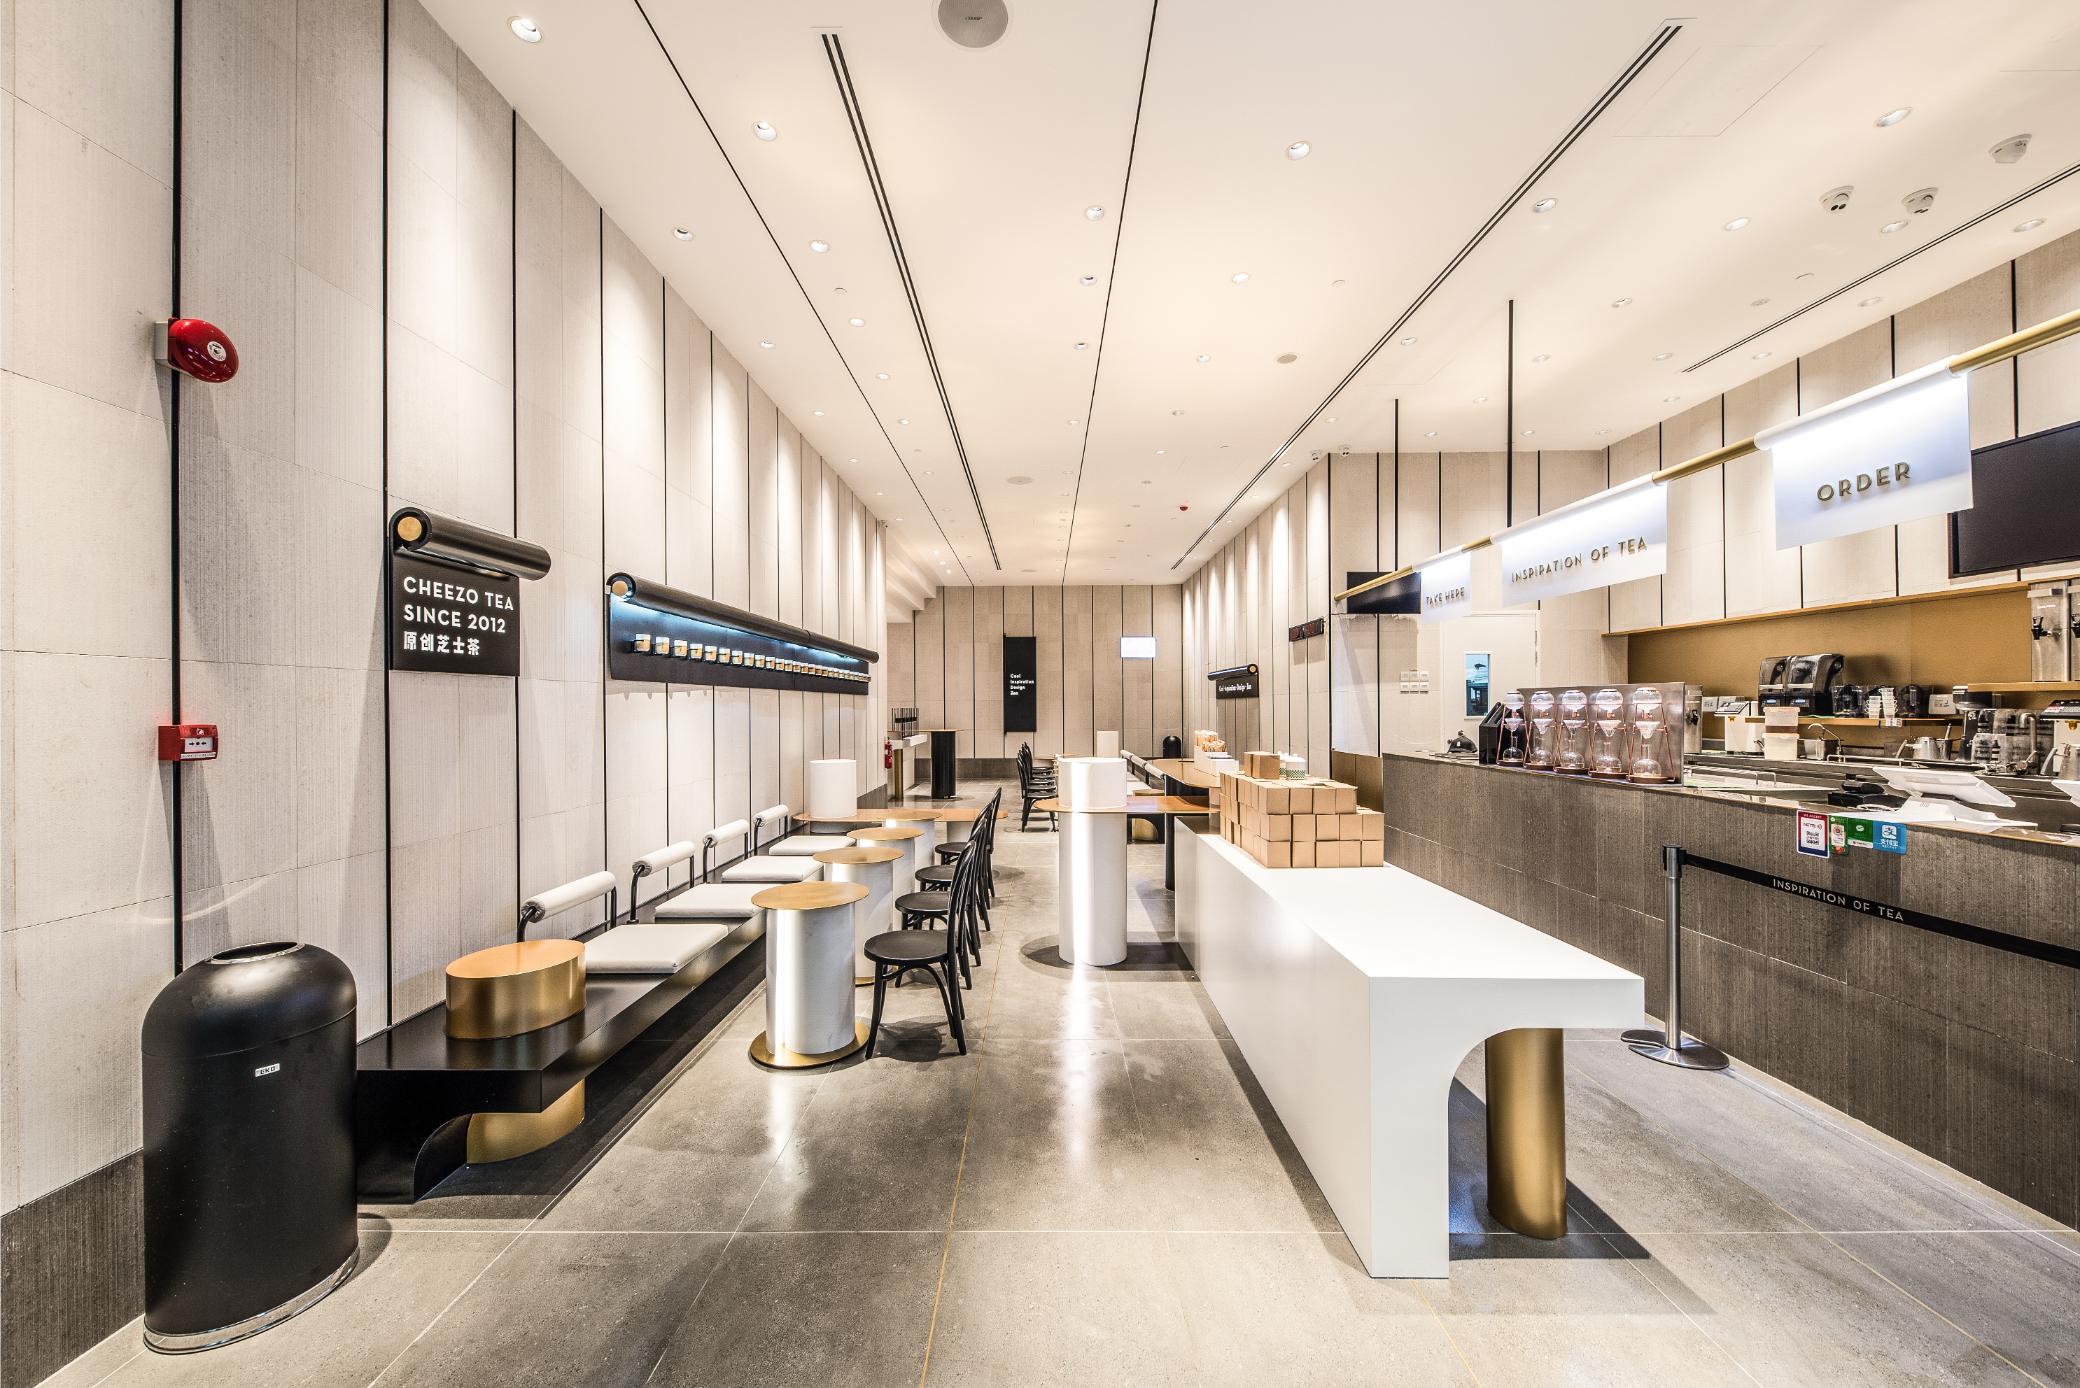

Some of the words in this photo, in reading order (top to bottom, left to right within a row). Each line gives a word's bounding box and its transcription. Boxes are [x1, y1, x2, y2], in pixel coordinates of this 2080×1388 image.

[1817, 461, 1911, 501] ORDER
[1511, 553, 1582, 583] INSPIRATION
[1590, 546, 1609, 561] OF
[1618, 536, 1647, 556] TEA
[403, 576, 479, 604] CHEEZO
[484, 592, 514, 611] TEA
[1426, 593, 1443, 605] TAKE
[1445, 586, 1465, 601] HERE
[403, 604, 461, 628] SINCE
[467, 613, 506, 633] 2012
[403, 630, 480, 656] 原创芝士茶
[1773, 878, 1846, 907] INSPIRATION
[1853, 900, 1871, 912] OF
[1878, 906, 1904, 922] TEA
